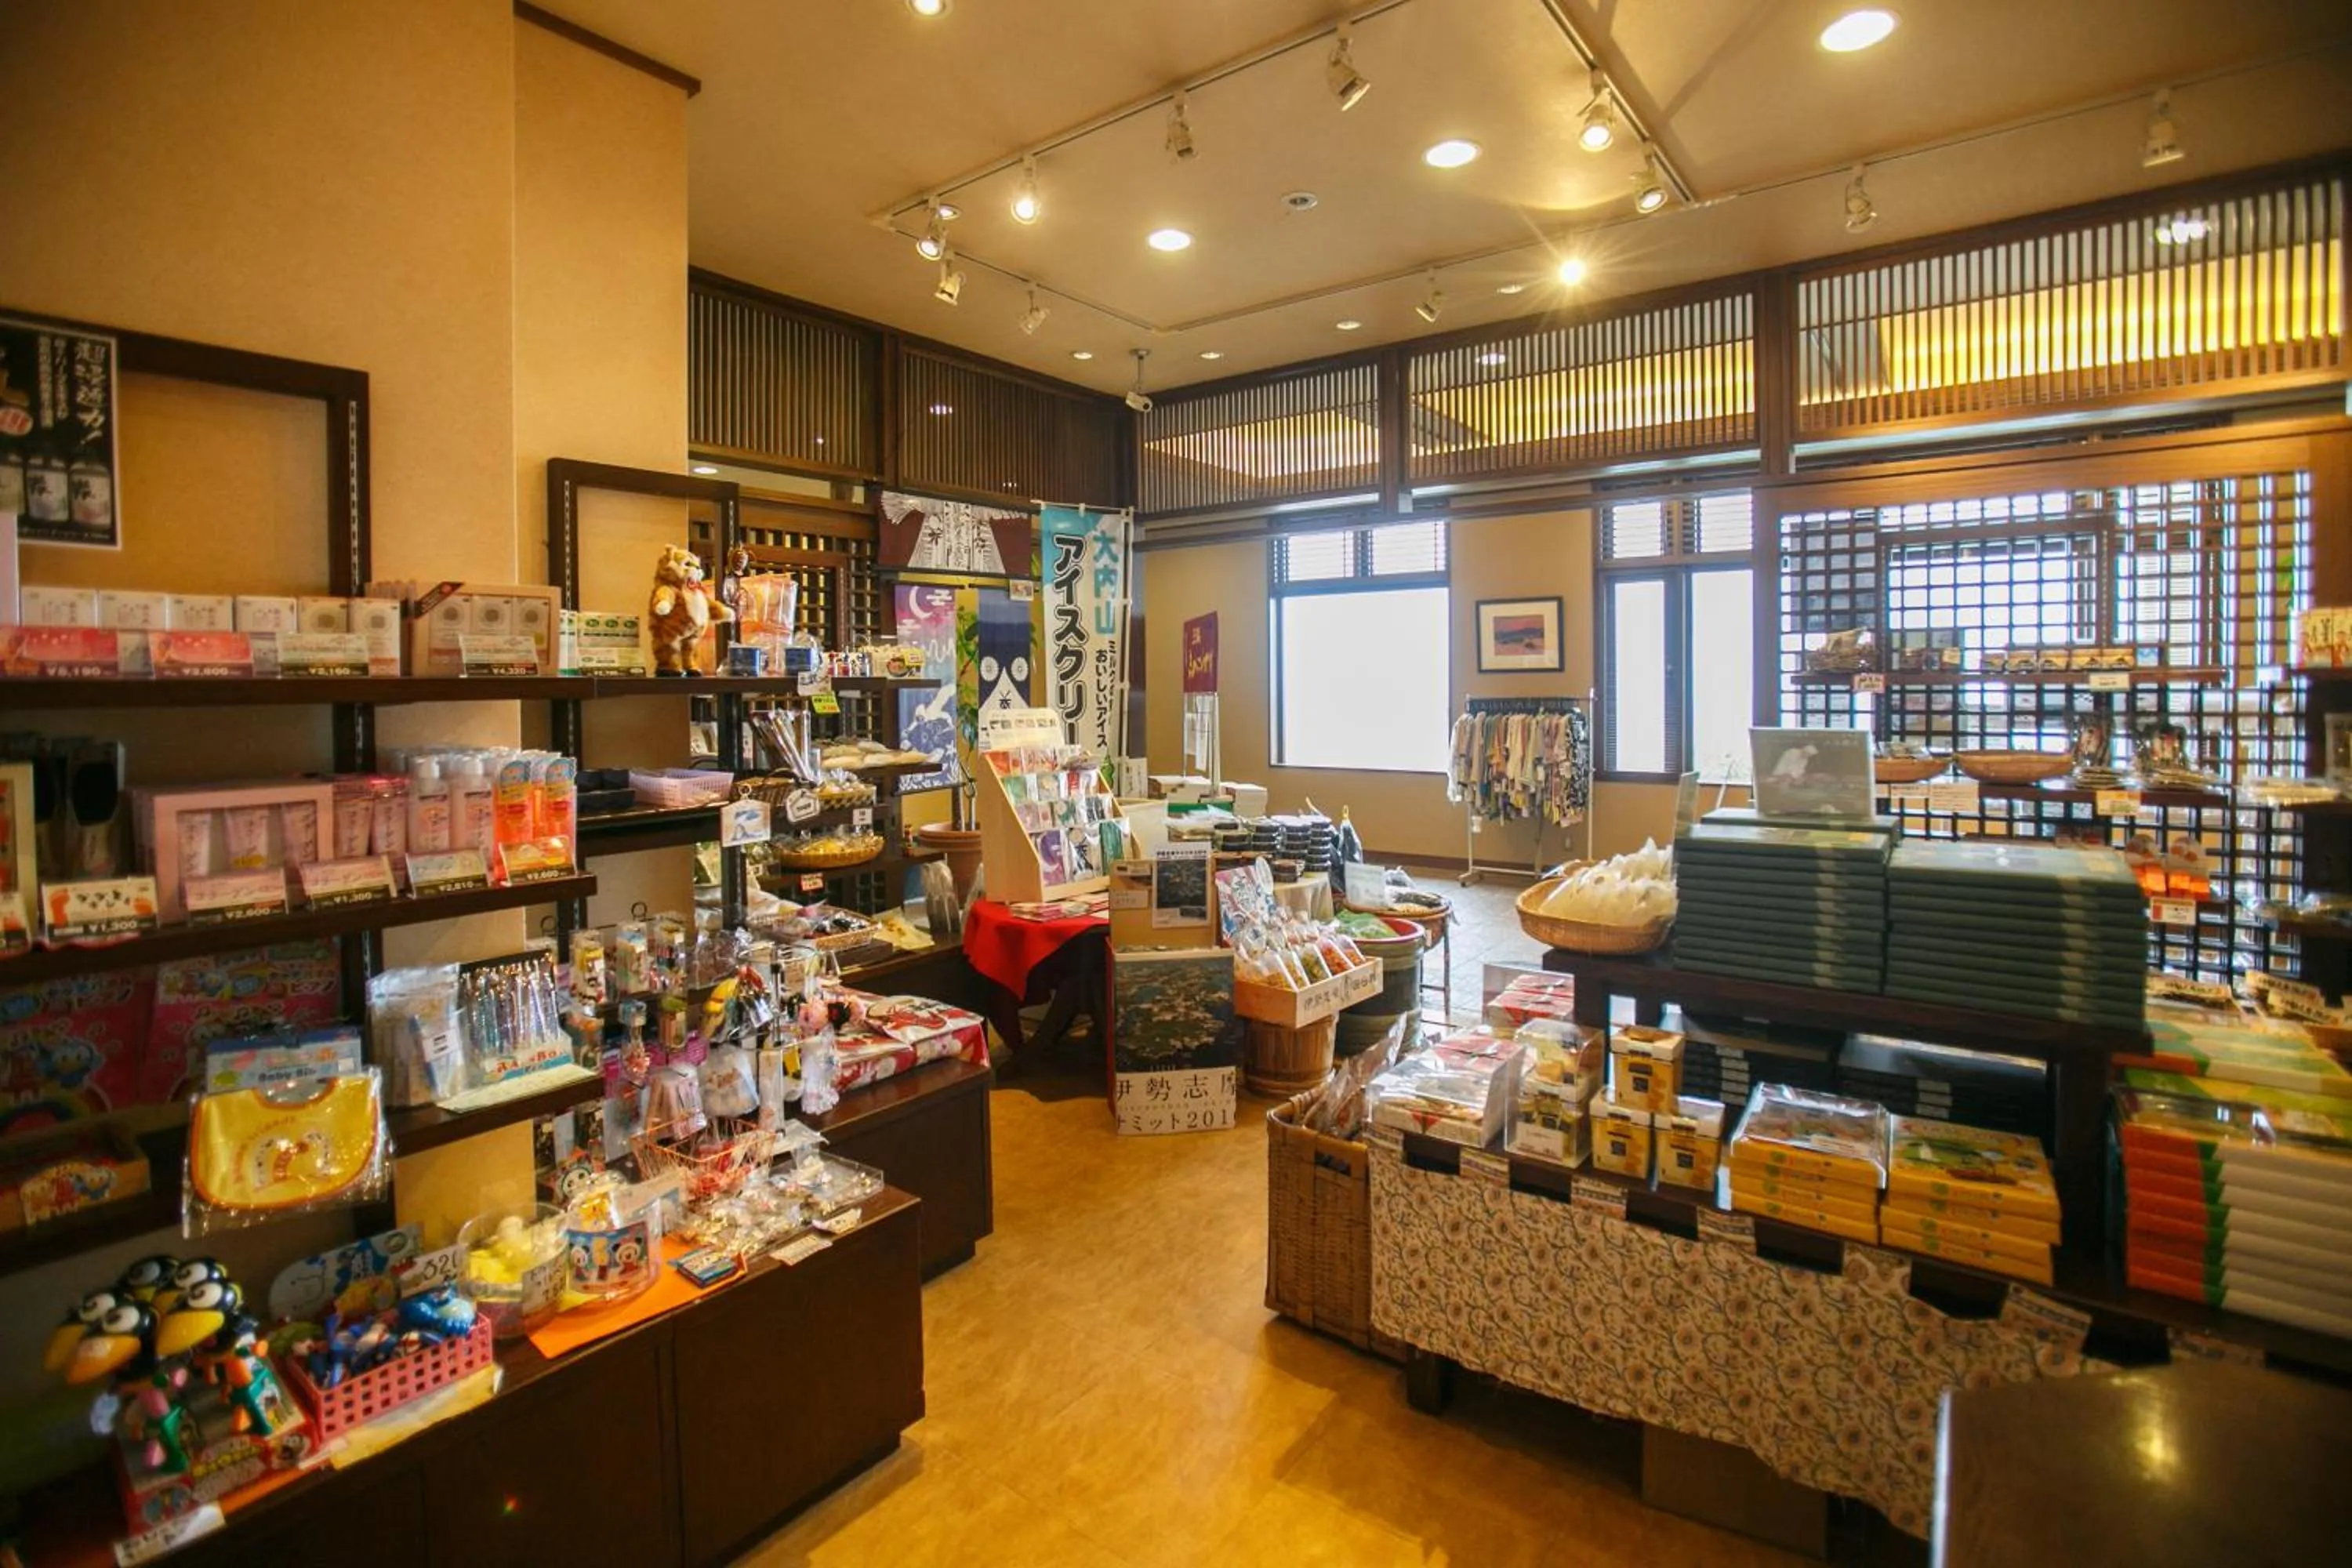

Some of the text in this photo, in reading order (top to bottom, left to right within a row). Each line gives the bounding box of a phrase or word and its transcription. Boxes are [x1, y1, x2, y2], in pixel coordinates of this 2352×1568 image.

[1093, 531, 1120, 634] 大内山
[1053, 534, 1090, 745] アイスクリー
[1095, 650, 1109, 748] おいしいアイス
[1116, 1109, 1236, 1131] ミット201
